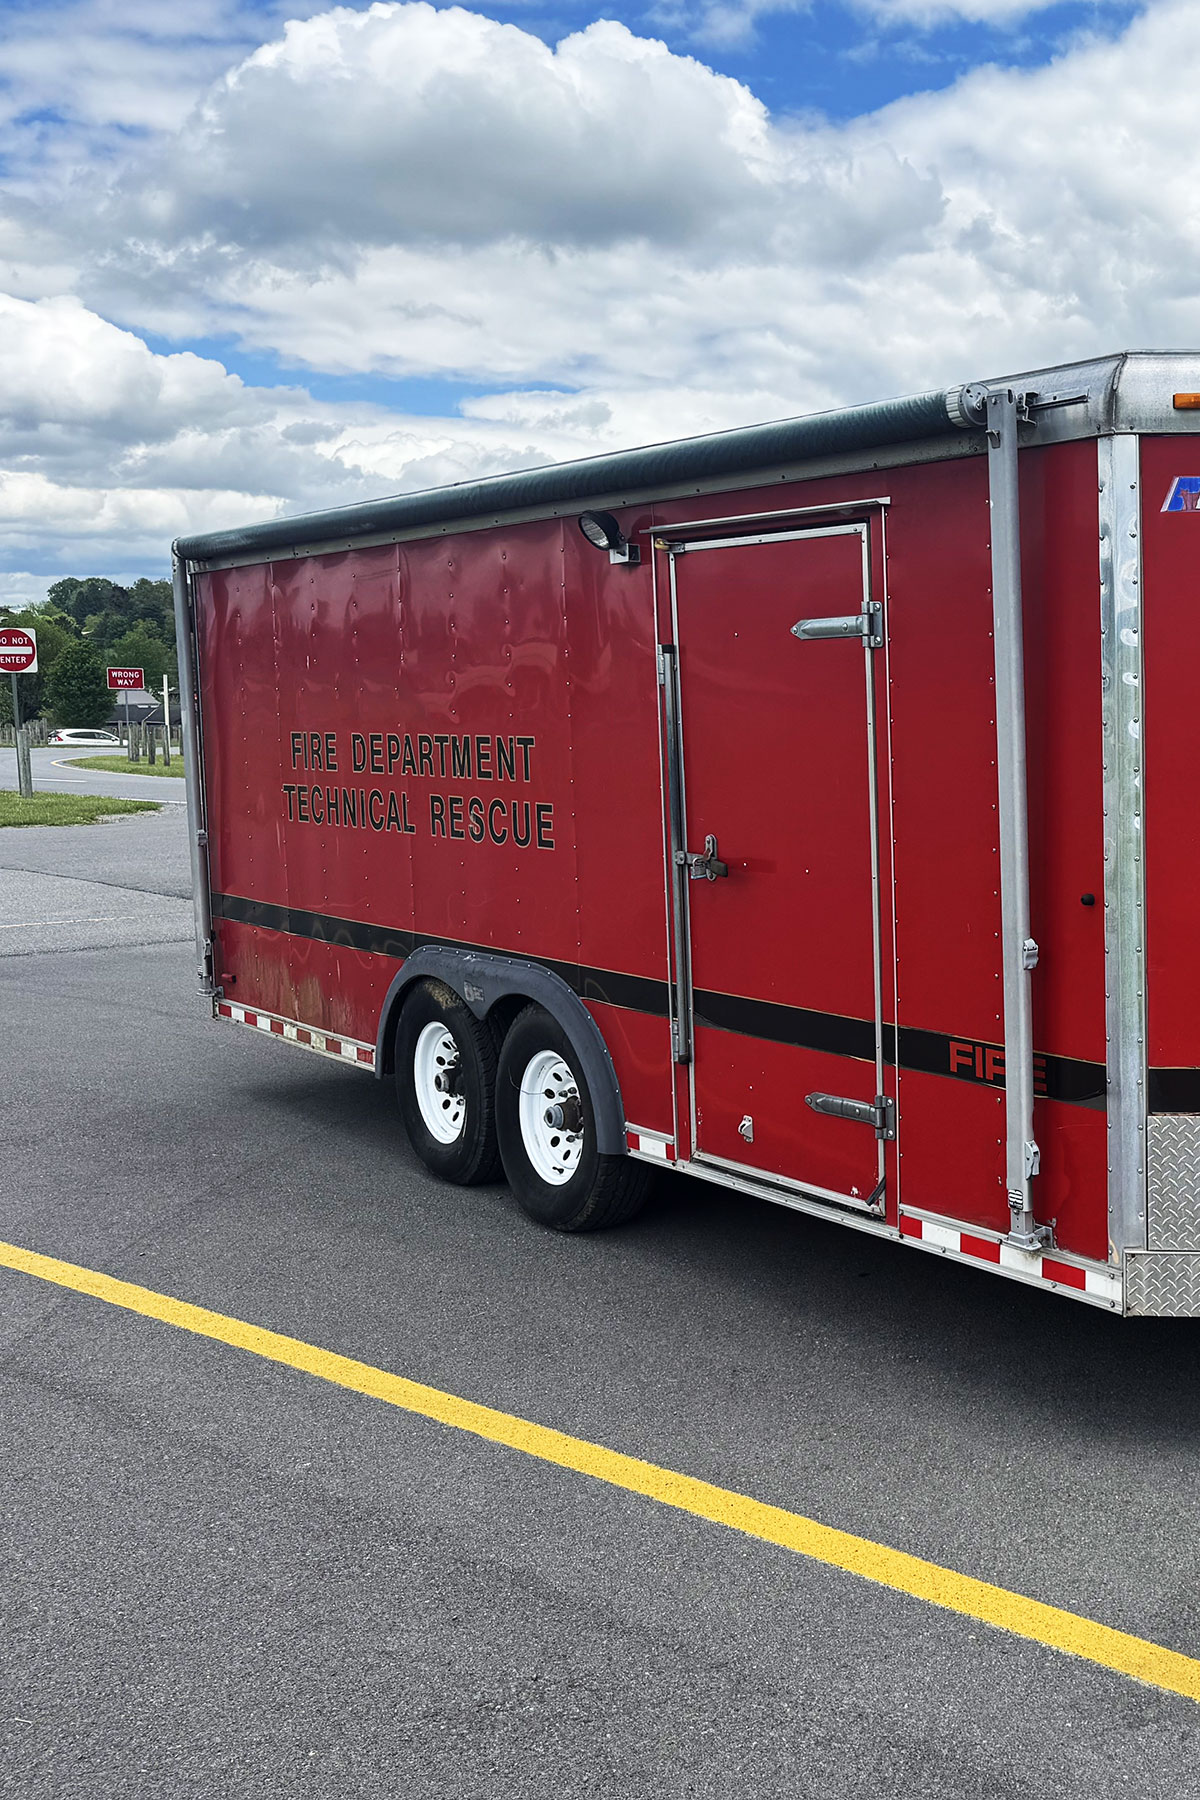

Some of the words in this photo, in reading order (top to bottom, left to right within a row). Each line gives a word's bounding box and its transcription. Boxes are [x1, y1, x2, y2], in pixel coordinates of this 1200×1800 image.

[0, 636, 7, 645] O
[12, 636, 28, 645] NOT
[0, 656, 27, 664] ENTER
[111, 671, 140, 679] WRONG
[290, 731, 338, 772] FIRE
[351, 732, 536, 782] DEPARTMENT
[283, 784, 416, 834] TECHNICAL
[429, 793, 555, 850] RESCUE
